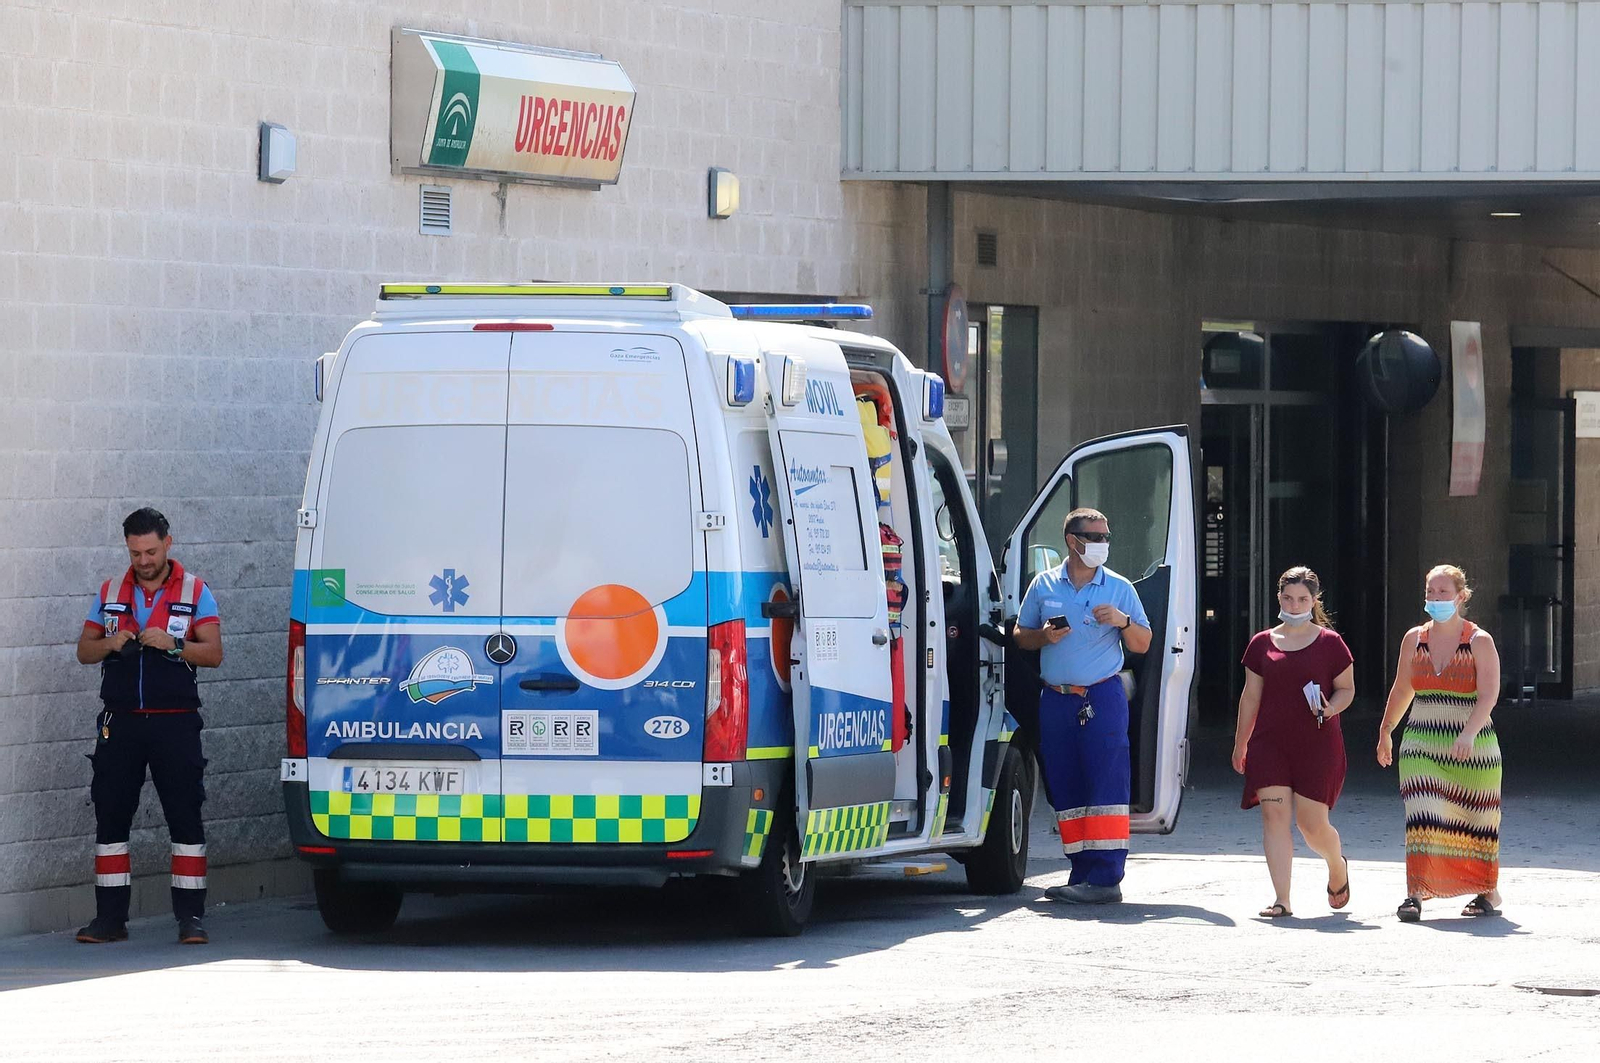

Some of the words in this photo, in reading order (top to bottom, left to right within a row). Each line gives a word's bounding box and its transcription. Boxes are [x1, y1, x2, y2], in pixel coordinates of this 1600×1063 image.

[514, 95, 625, 162] URGENCIAS
[359, 376, 663, 420] URGENCIAS
[805, 378, 844, 416] MOVIL
[316, 677, 392, 685] SPRINTER
[643, 680, 669, 688] 314
[671, 680, 697, 688] CDI
[325, 720, 483, 740] AMBULANCIA
[510, 720, 524, 736] ER
[554, 720, 568, 736] ER
[576, 720, 591, 736] ER
[652, 720, 683, 735] 278
[818, 709, 886, 750] URGENCIAS
[357, 770, 410, 791] 4134
[418, 771, 459, 792] KWF
